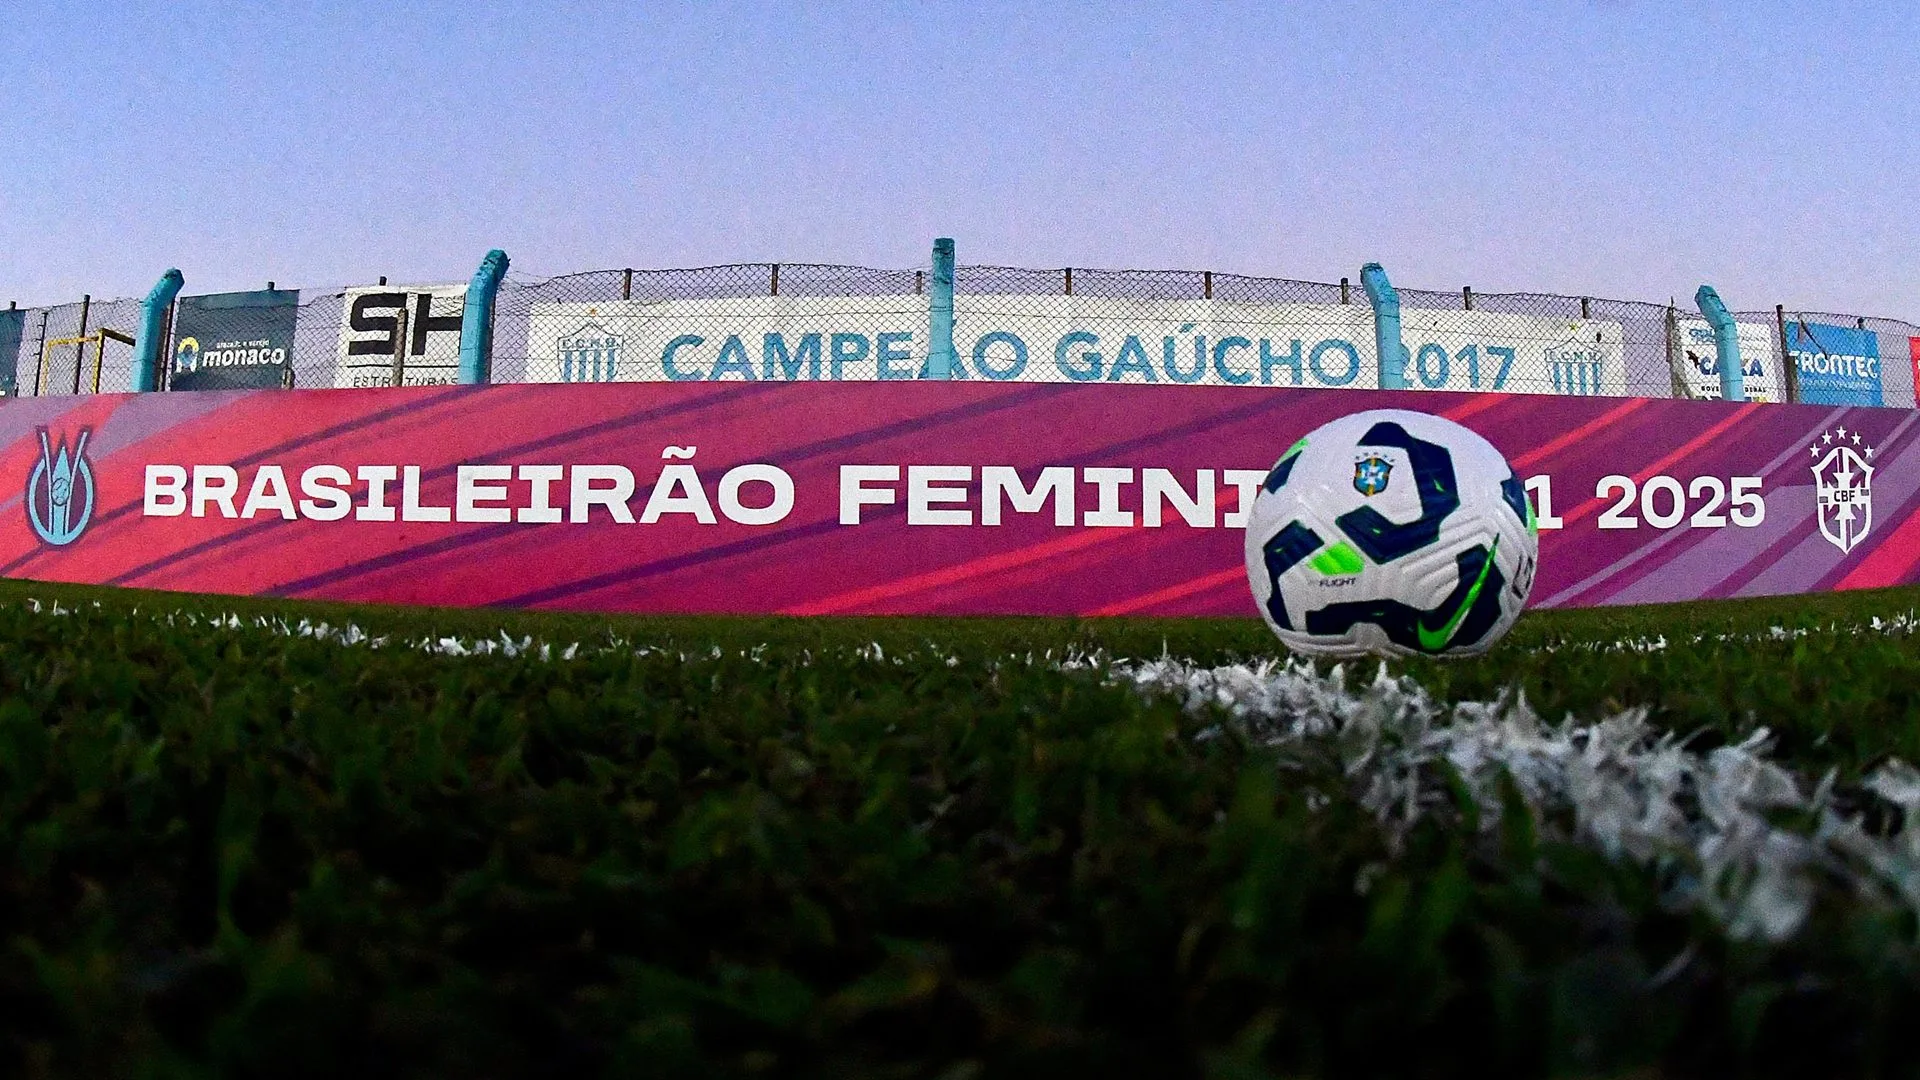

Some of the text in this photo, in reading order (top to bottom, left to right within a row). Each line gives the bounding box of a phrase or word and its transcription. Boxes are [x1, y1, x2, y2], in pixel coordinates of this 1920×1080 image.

[202, 347, 286, 368] monaco
[1053, 323, 1361, 385] GAÚCHO
[1699, 356, 1764, 377] CAA
[353, 375, 459, 388] ESTRTURAS
[142, 446, 1766, 530] BRASILEIRÃO FEMINI 1 2025
[1833, 490, 1855, 502] CBF
